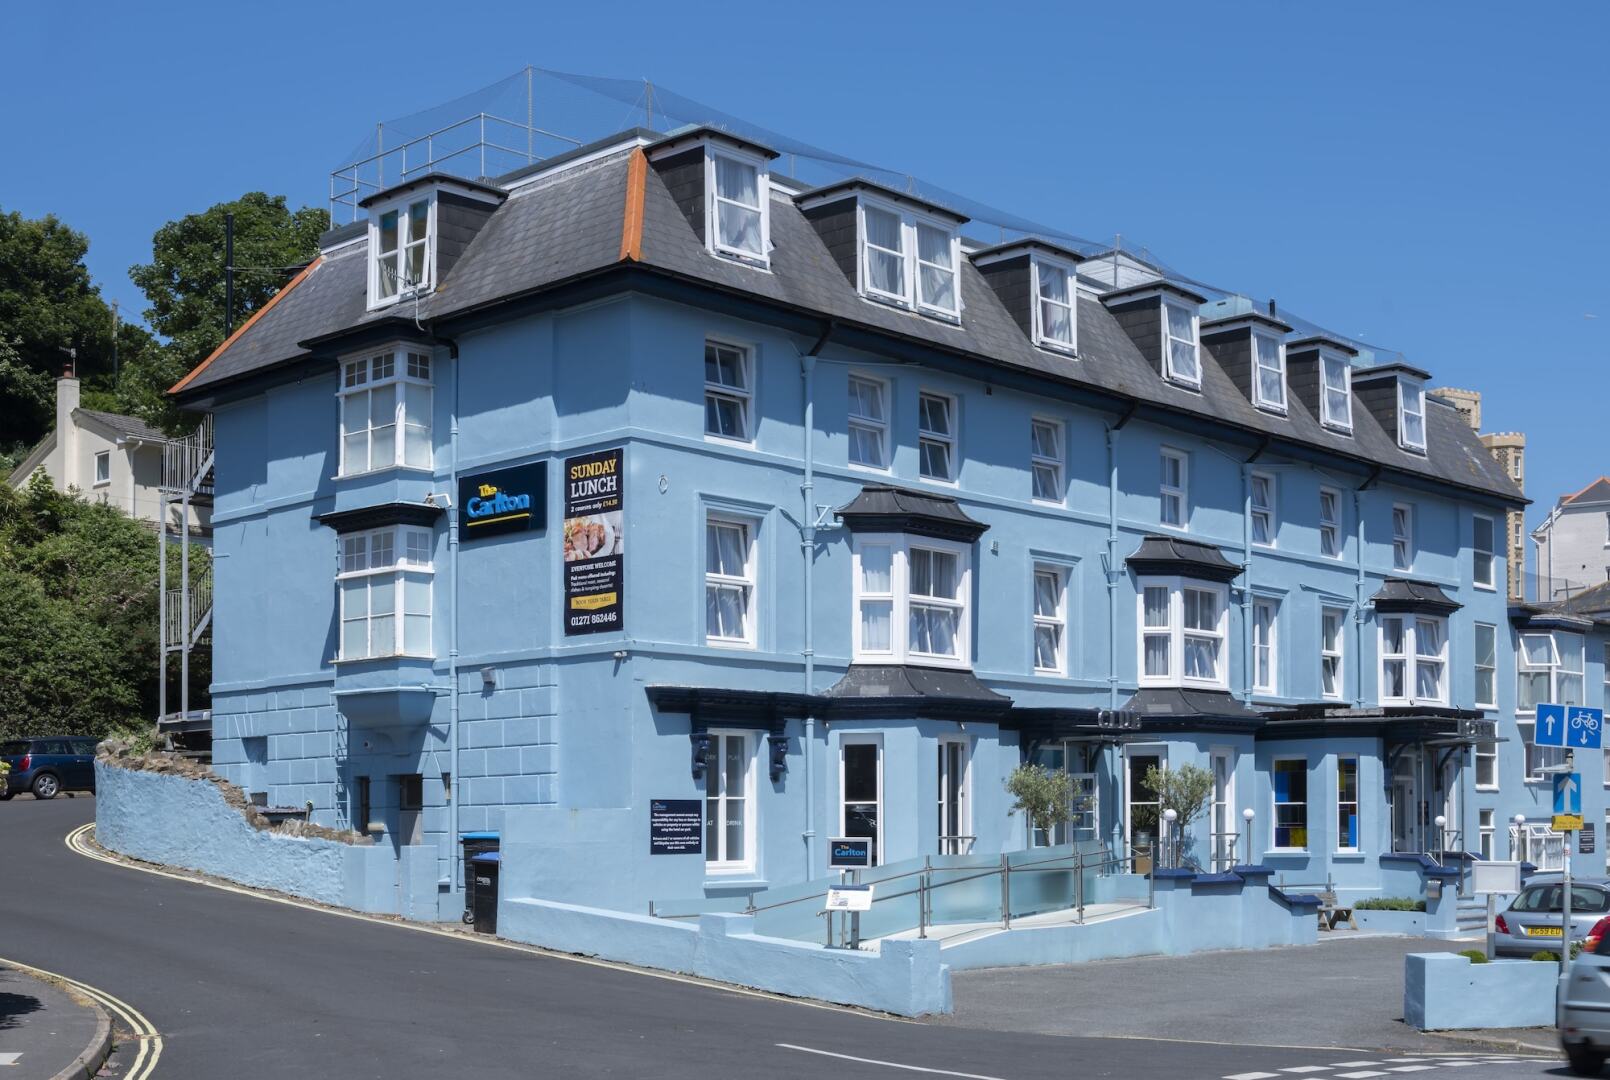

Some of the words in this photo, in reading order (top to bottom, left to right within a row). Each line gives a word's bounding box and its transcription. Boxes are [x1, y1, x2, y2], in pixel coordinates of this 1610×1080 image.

[571, 459, 617, 479] SUNDAY
[478, 484, 498, 497] The
[571, 475, 617, 498] LUNCH
[467, 492, 530, 518] Carlton
[595, 560, 616, 569] WELCOME
[571, 615, 590, 626] 01271
[591, 612, 617, 624] 862446
